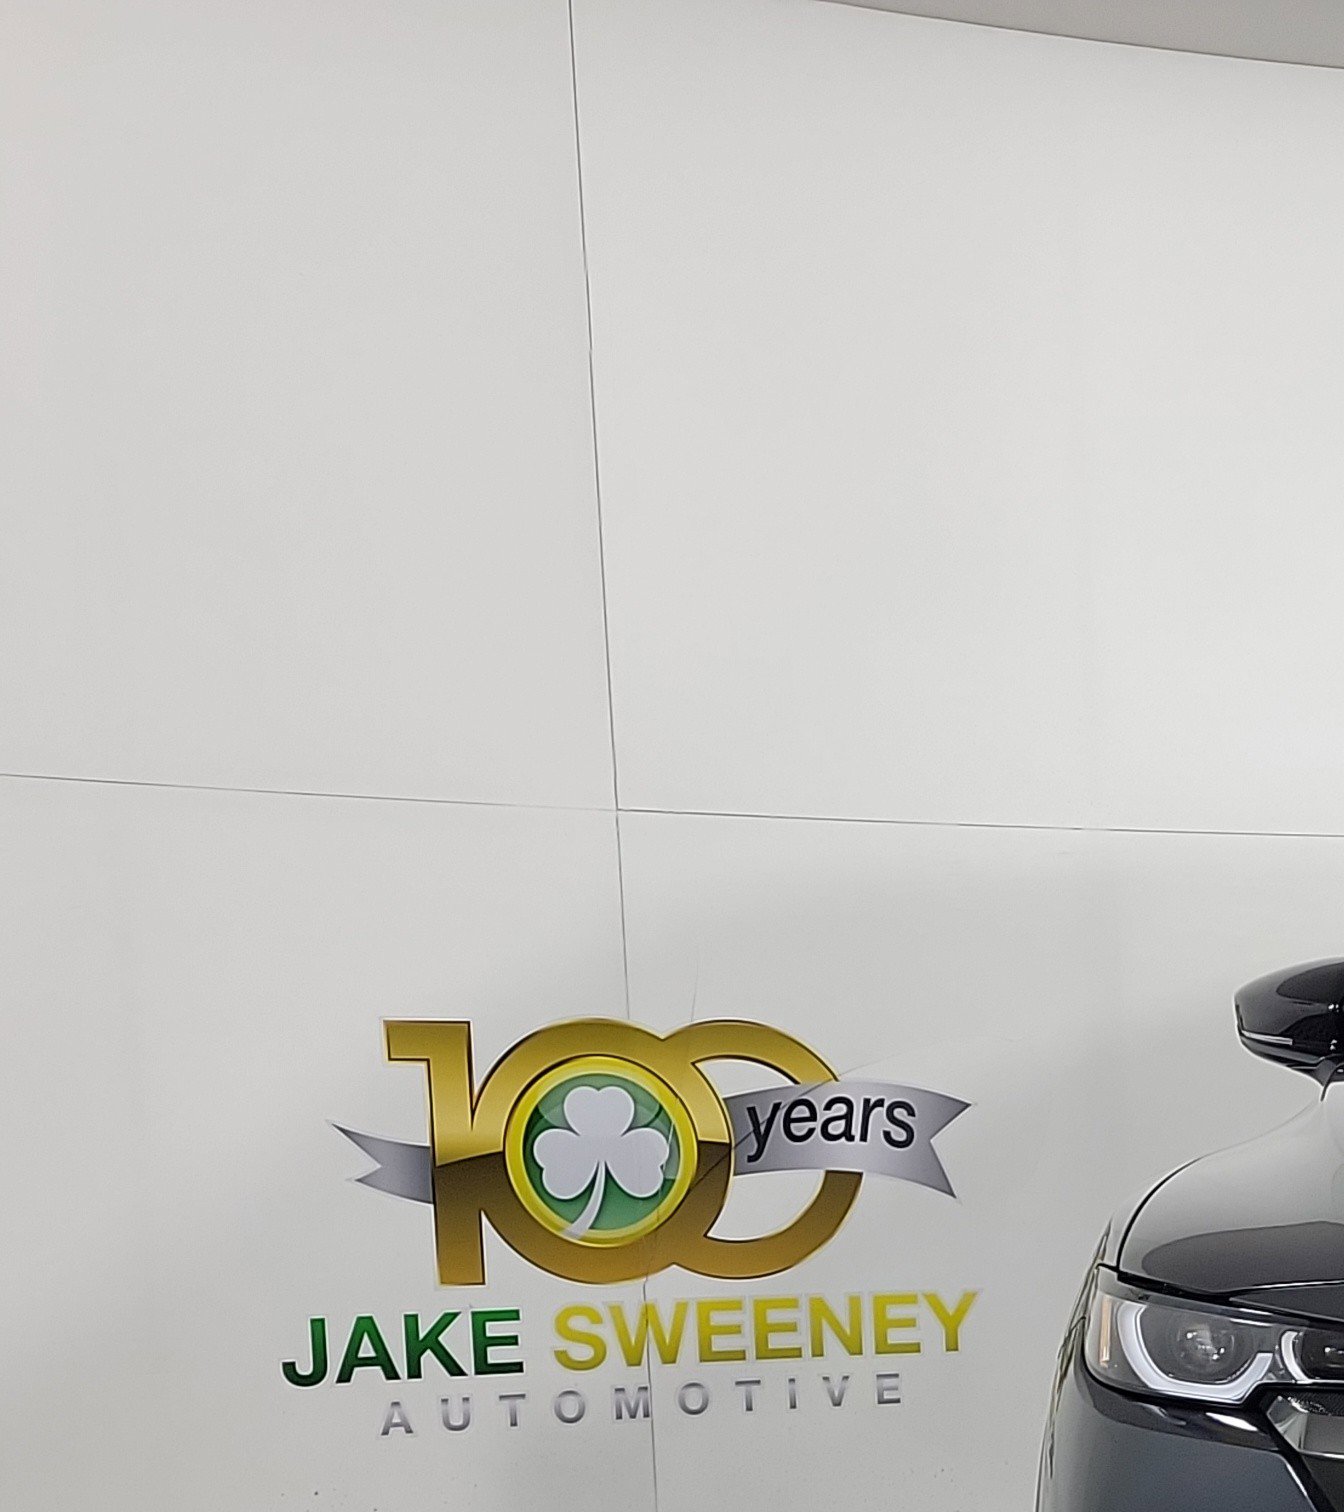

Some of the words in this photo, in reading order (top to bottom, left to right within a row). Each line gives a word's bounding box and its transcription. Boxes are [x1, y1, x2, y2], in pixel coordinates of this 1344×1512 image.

[384, 1018, 864, 1286] 100
[746, 1095, 916, 1162] years
[282, 1310, 524, 1387] JAKE
[553, 1292, 979, 1371] SWEENEY
[380, 1374, 902, 1437] AUTOMOTIVE
